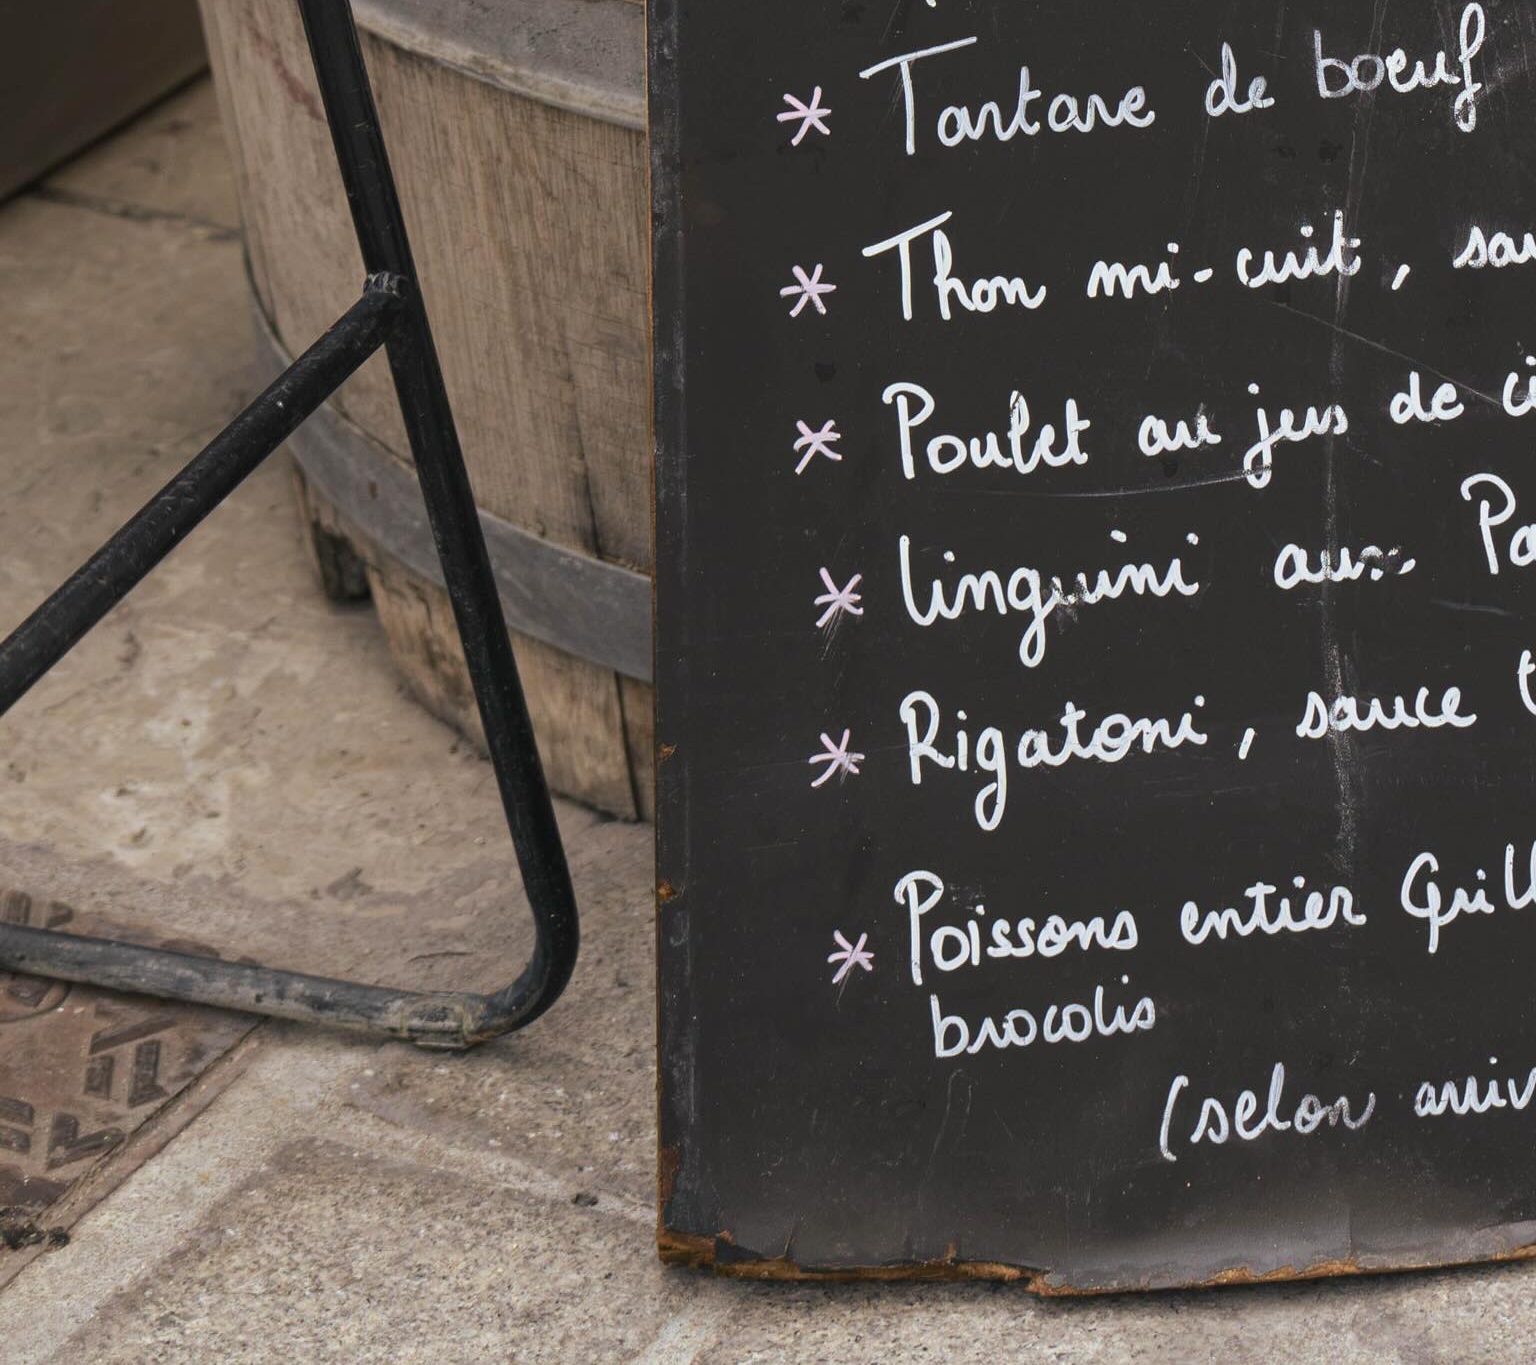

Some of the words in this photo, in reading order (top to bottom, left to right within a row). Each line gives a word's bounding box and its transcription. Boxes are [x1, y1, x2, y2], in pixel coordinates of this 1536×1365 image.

[859, 36, 1155, 155] Tartare
[1205, 42, 1275, 117] de
[862, 211, 1046, 321] Thon
[882, 382, 1090, 479] Poulet
[1138, 403, 1221, 456] au
[1390, 371, 1464, 424] de
[1296, 682, 1477, 744] sauce
[894, 870, 1138, 985] Poissons
[1181, 876, 1367, 945] entier
[930, 985, 1155, 1058] brocolis
[1160, 1062, 1375, 1161] (selon
